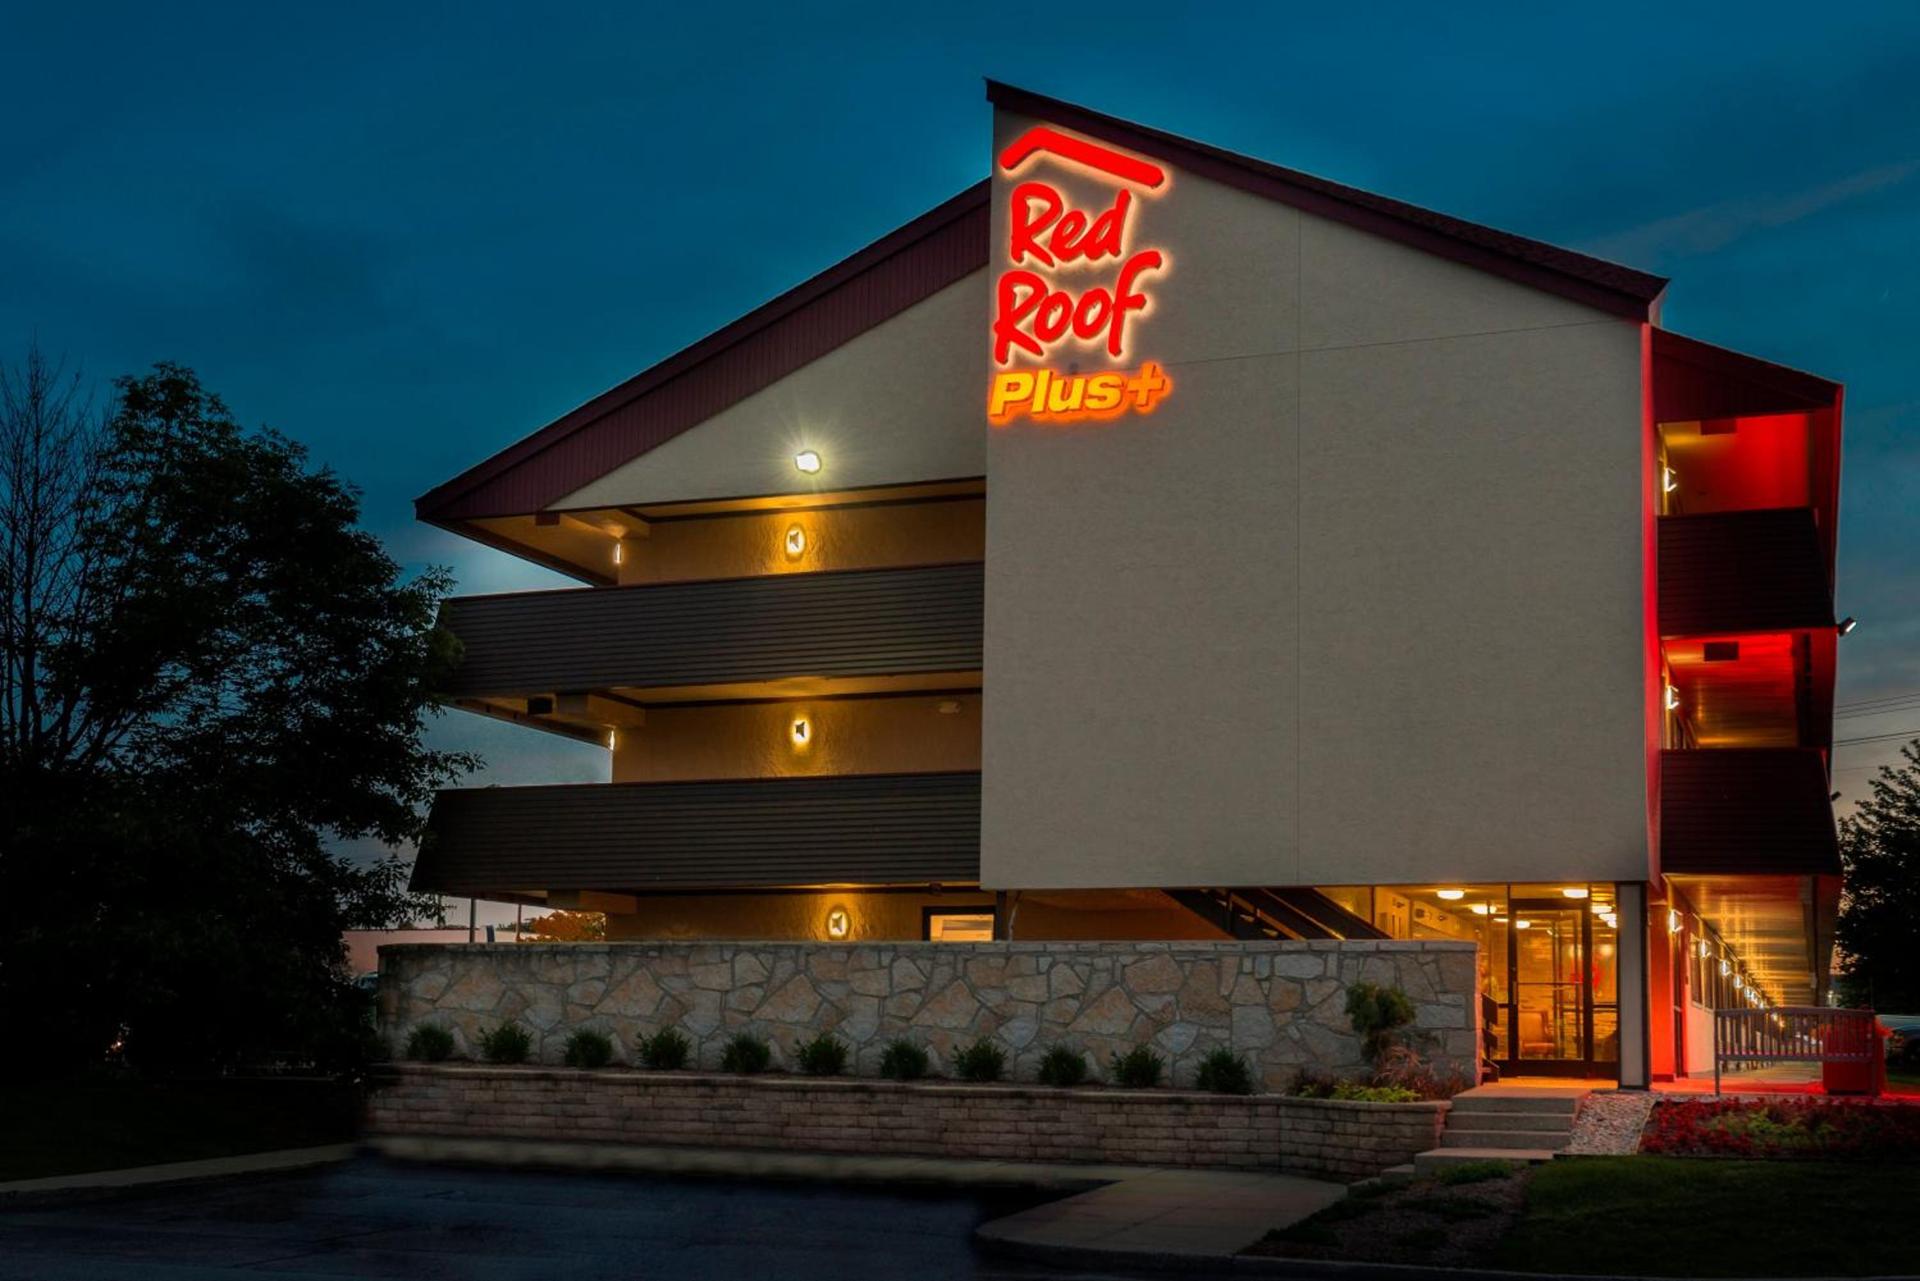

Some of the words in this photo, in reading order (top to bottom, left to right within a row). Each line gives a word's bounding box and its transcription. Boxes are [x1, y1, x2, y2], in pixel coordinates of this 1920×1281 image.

[1010, 182, 1131, 267] Red
[993, 250, 1162, 365] Roof
[989, 363, 1166, 417] Plus+
